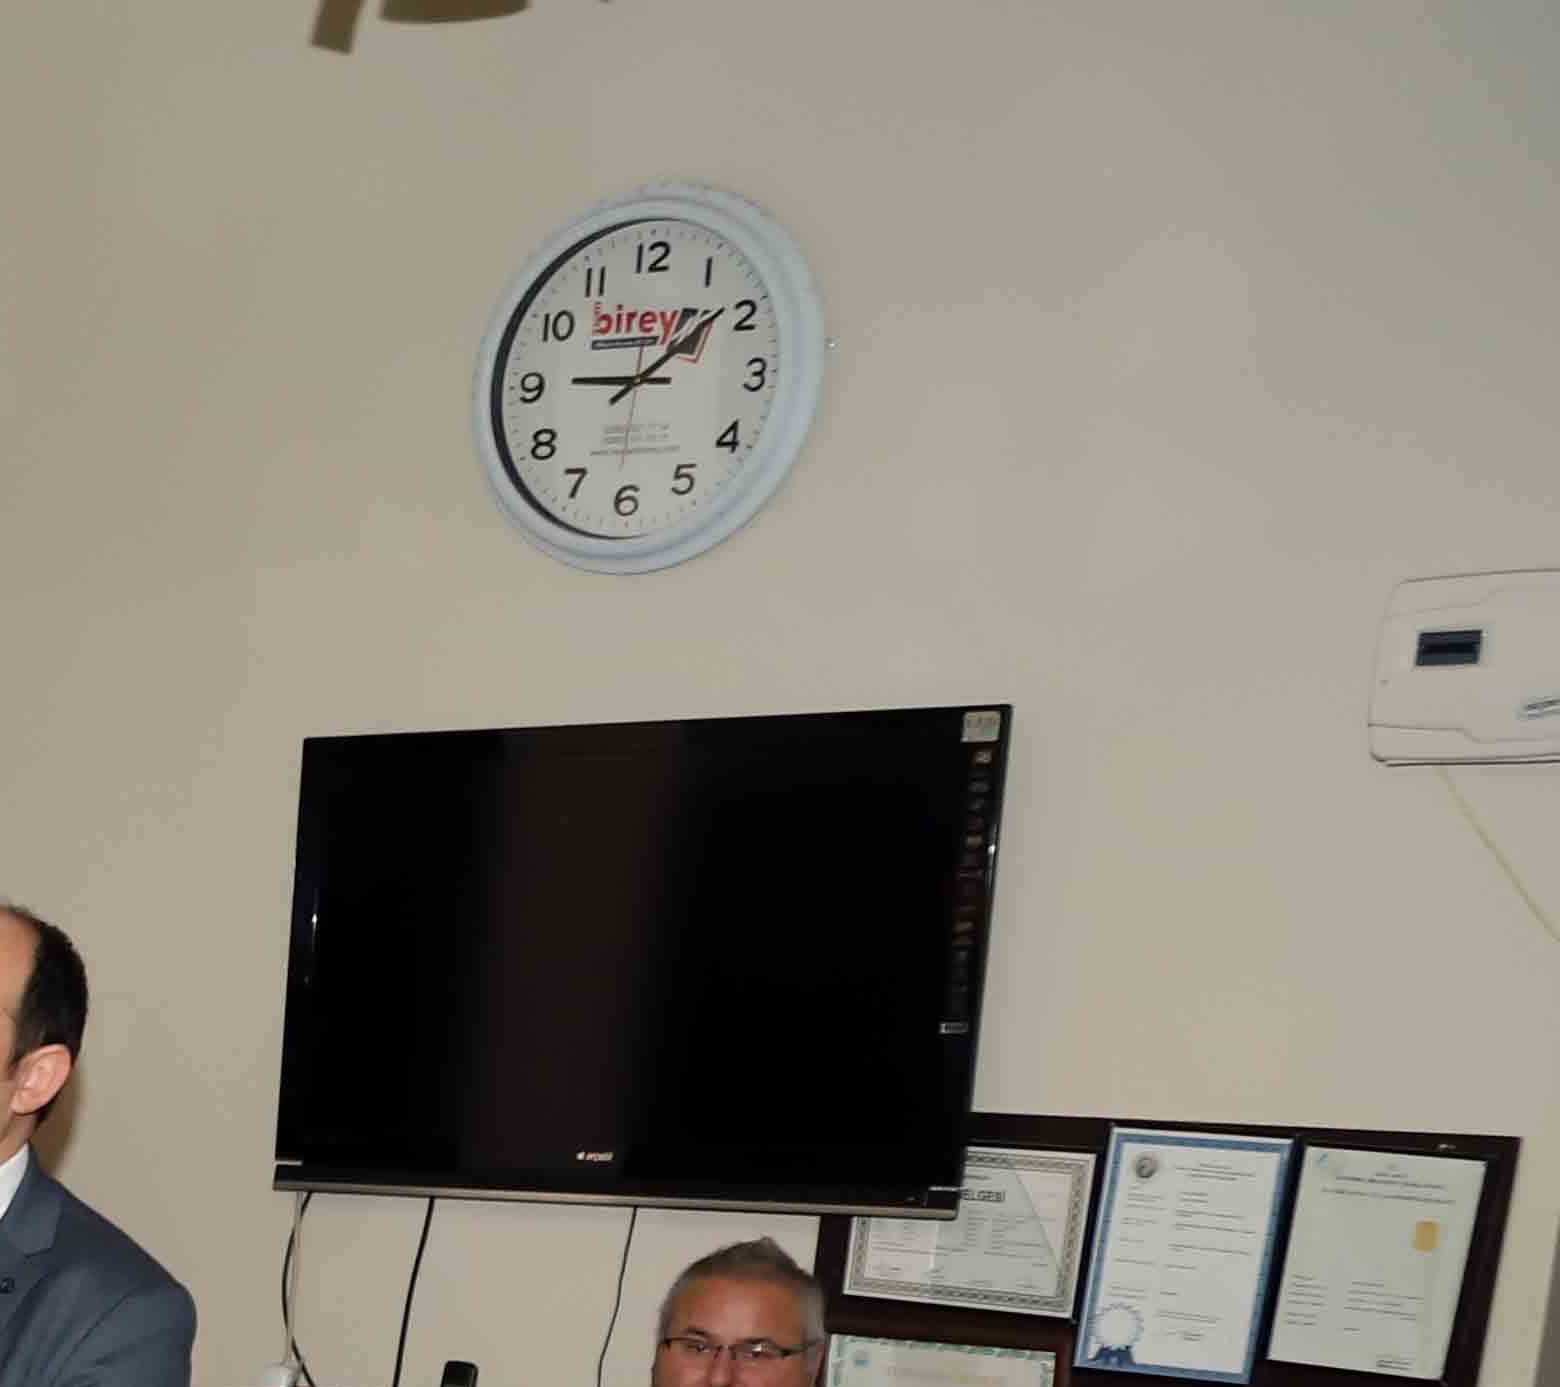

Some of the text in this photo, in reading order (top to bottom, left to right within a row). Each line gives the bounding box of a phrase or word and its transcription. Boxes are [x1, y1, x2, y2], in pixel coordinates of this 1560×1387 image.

[635, 241, 671, 274] 12
[704, 256, 713, 288] 1
[584, 265, 606, 298] 11
[541, 310, 576, 342] 10
[592, 300, 680, 345] birey
[732, 299, 757, 331] 2
[519, 372, 546, 404] 9
[742, 357, 767, 392] 3
[529, 428, 557, 461] 8
[715, 418, 740, 454] 4
[564, 467, 588, 500] 7
[670, 463, 697, 495] 5
[613, 484, 640, 516] 6
